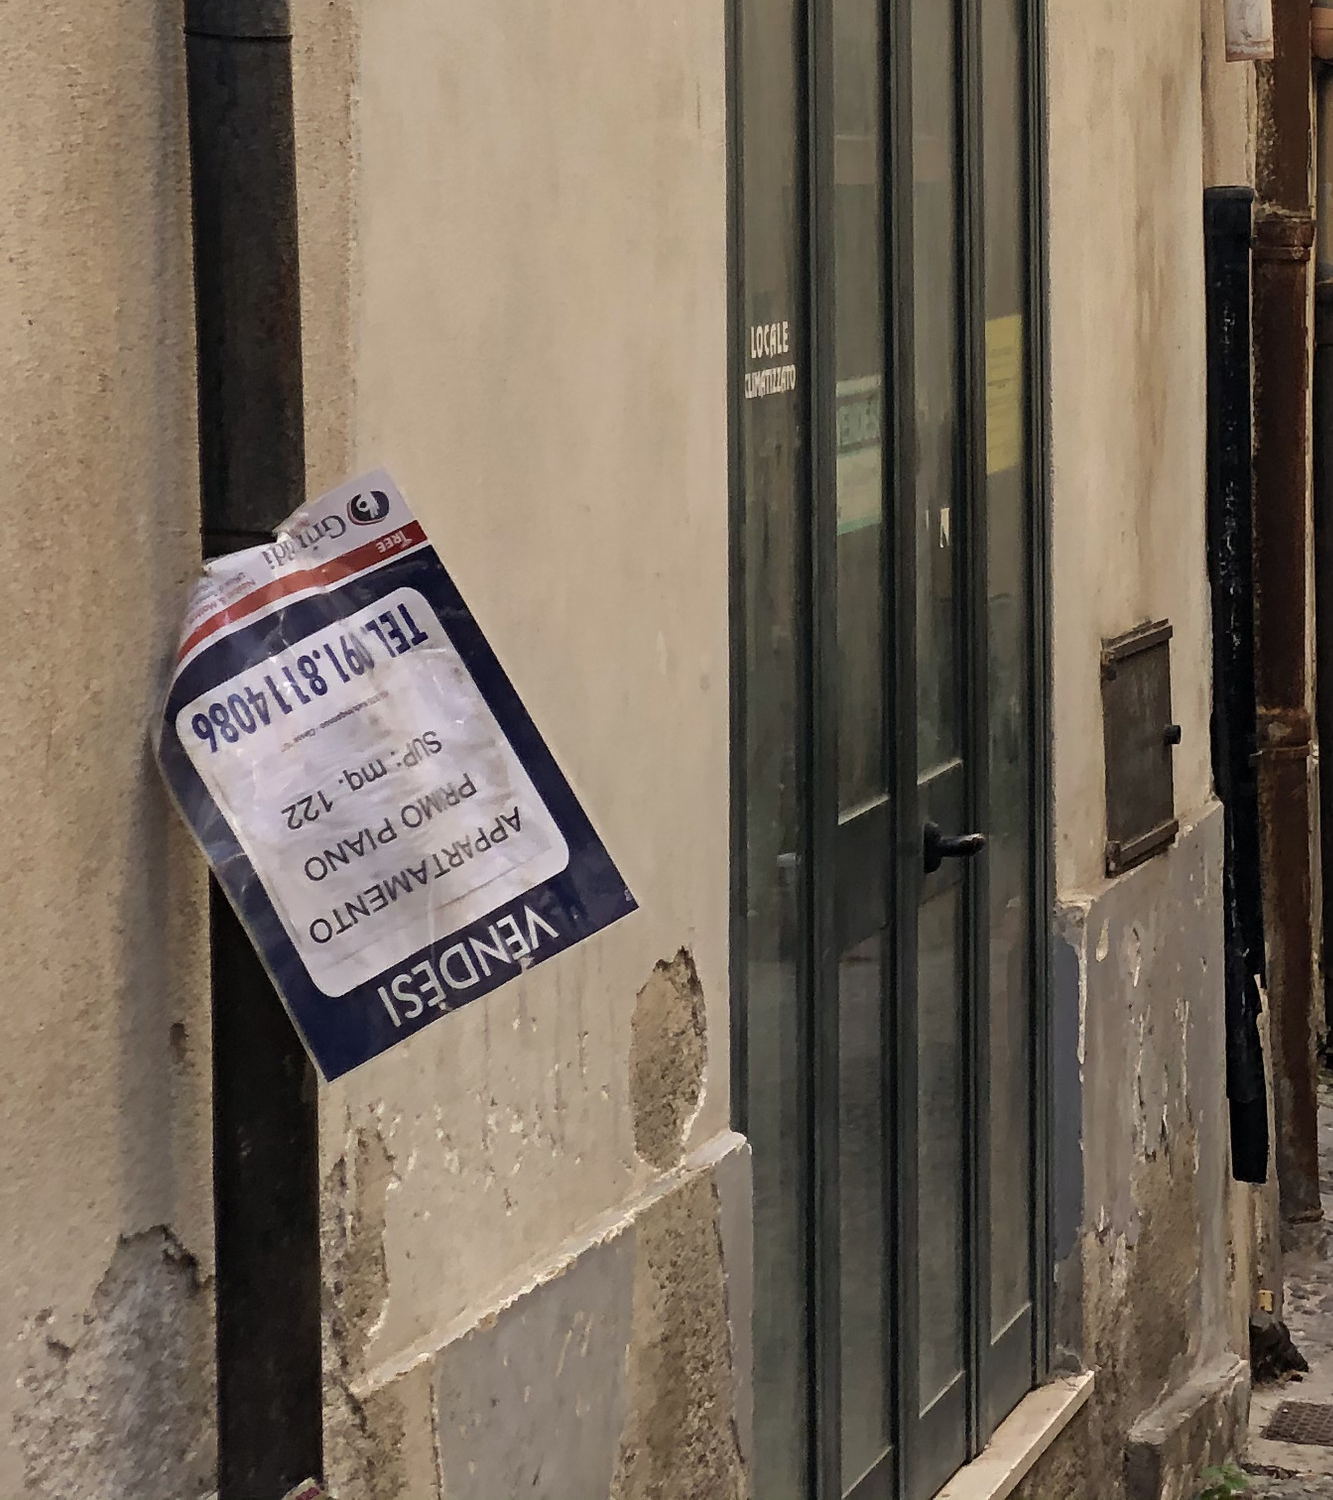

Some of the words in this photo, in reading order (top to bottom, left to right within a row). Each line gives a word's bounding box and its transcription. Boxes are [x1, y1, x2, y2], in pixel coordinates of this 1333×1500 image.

[751, 321, 788, 358] LOCALE
[745, 364, 796, 399] CLIMATIZZATO
[376, 528, 411, 554] TREE
[391, 729, 443, 769] SUP:
[338, 759, 388, 792] mq.
[281, 789, 334, 831] 122
[401, 772, 479, 830] PRIMO
[304, 816, 397, 883] PIANO
[309, 806, 523, 945] APPARTAMENTO
[377, 905, 559, 1028] VENDESI
